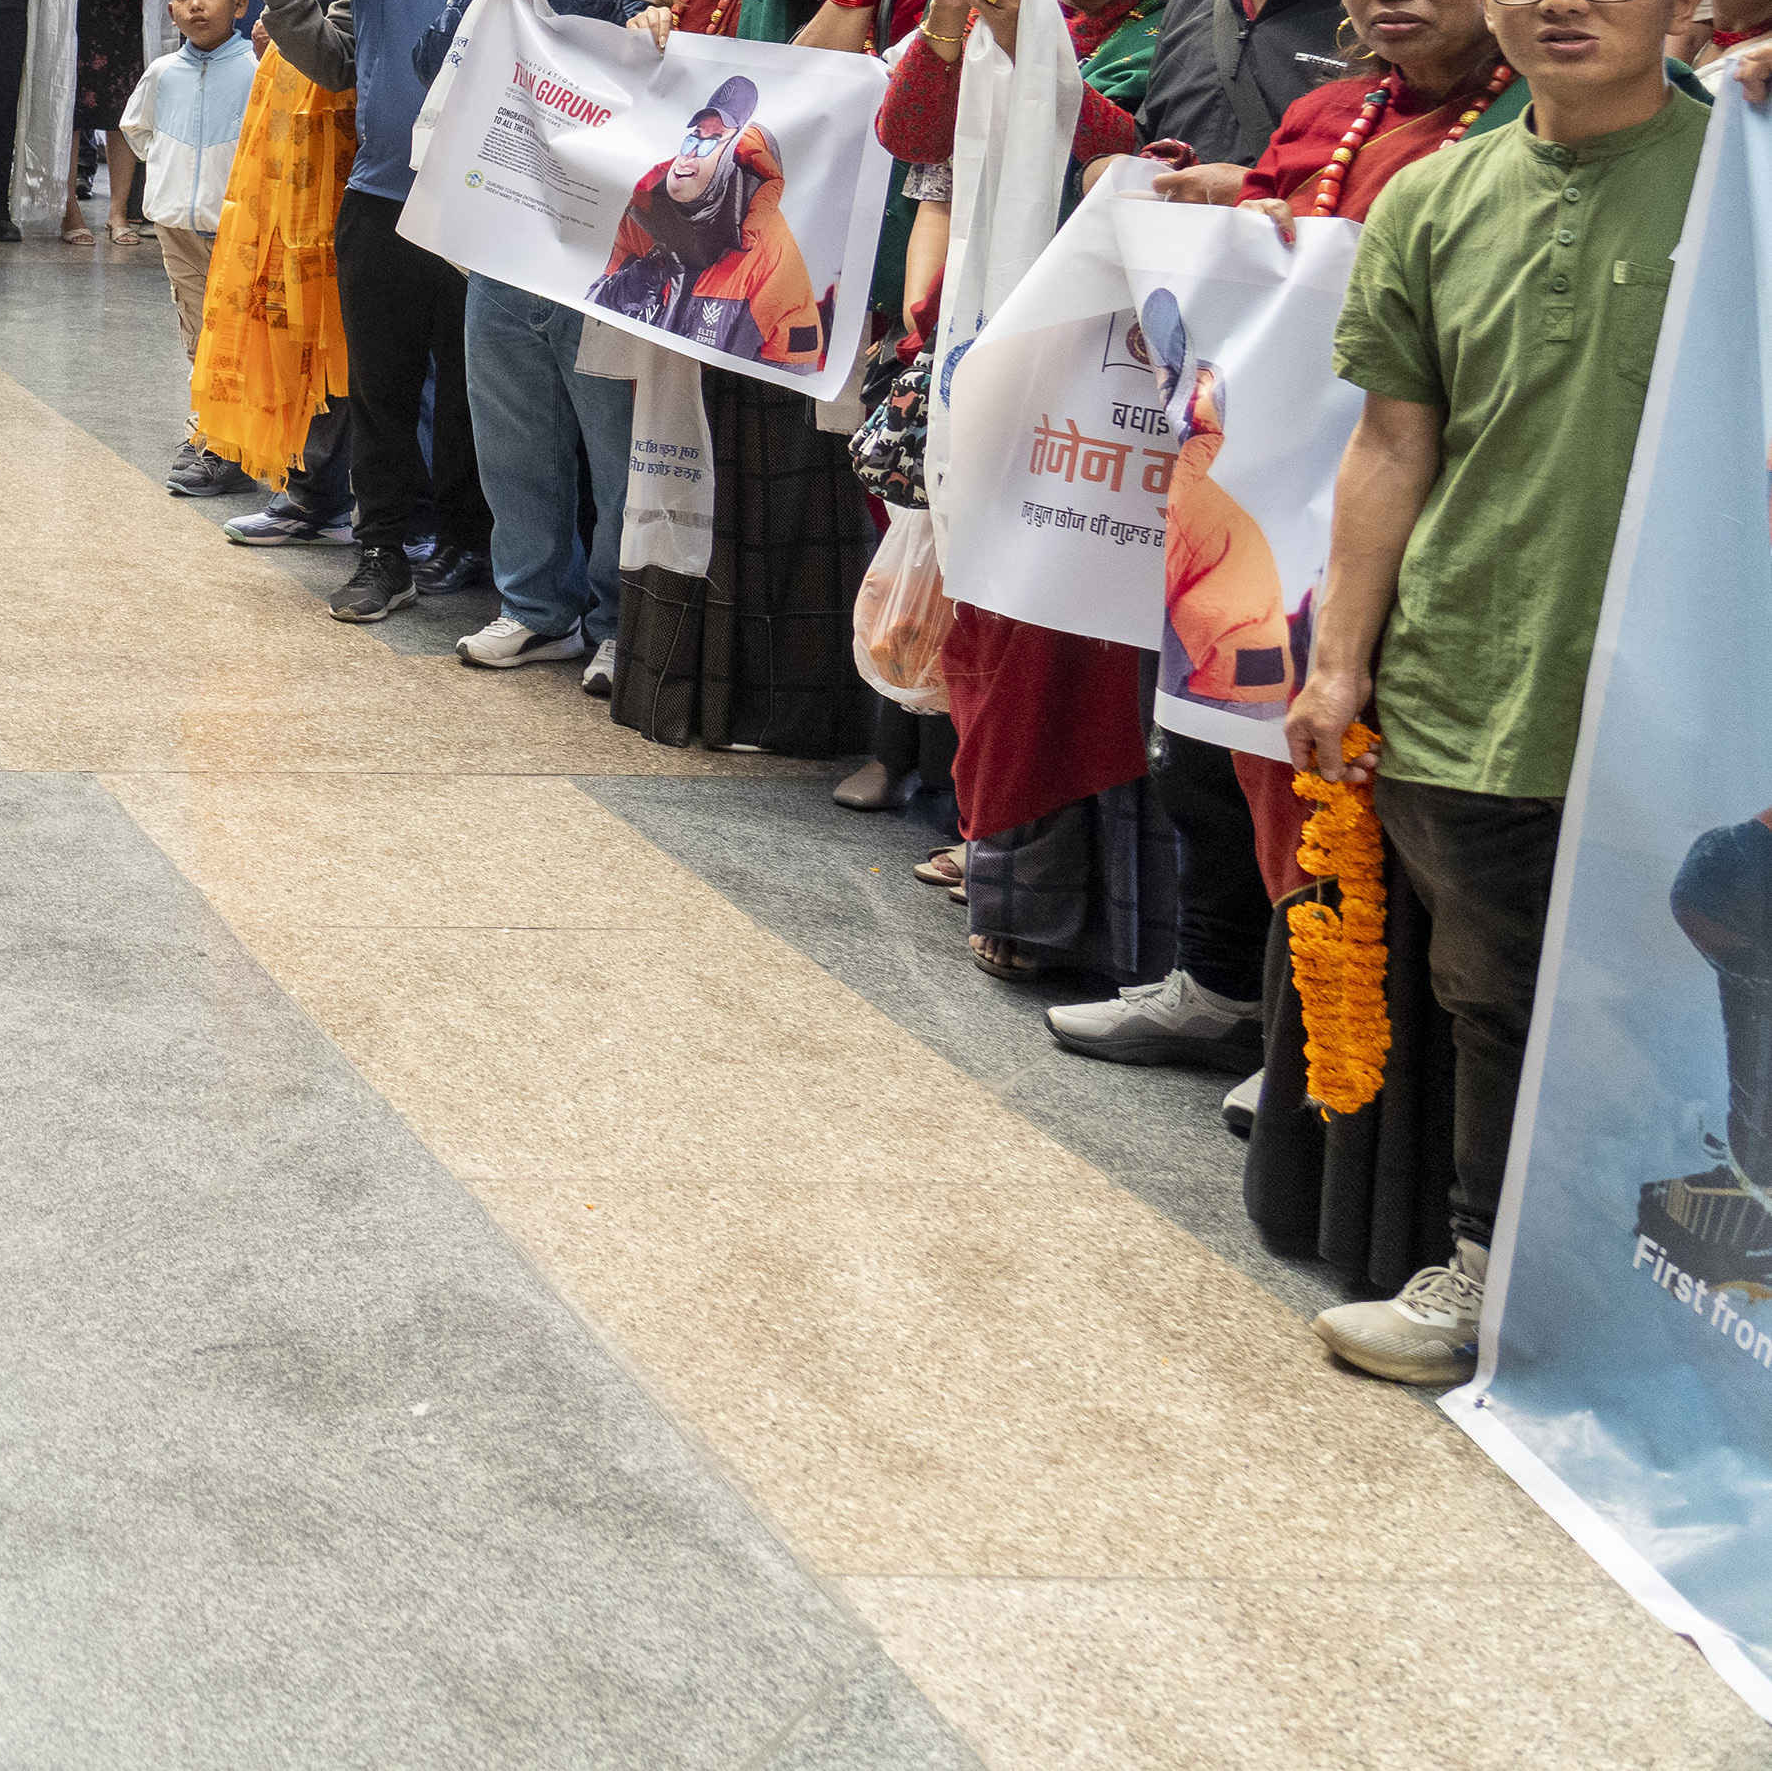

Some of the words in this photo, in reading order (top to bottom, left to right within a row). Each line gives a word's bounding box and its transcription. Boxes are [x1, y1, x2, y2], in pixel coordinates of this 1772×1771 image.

[536, 79, 612, 129] GURUNG
[696, 335, 716, 345] EXPED
[698, 327, 716, 338] ELITE
[1632, 1233, 1708, 1316] First
